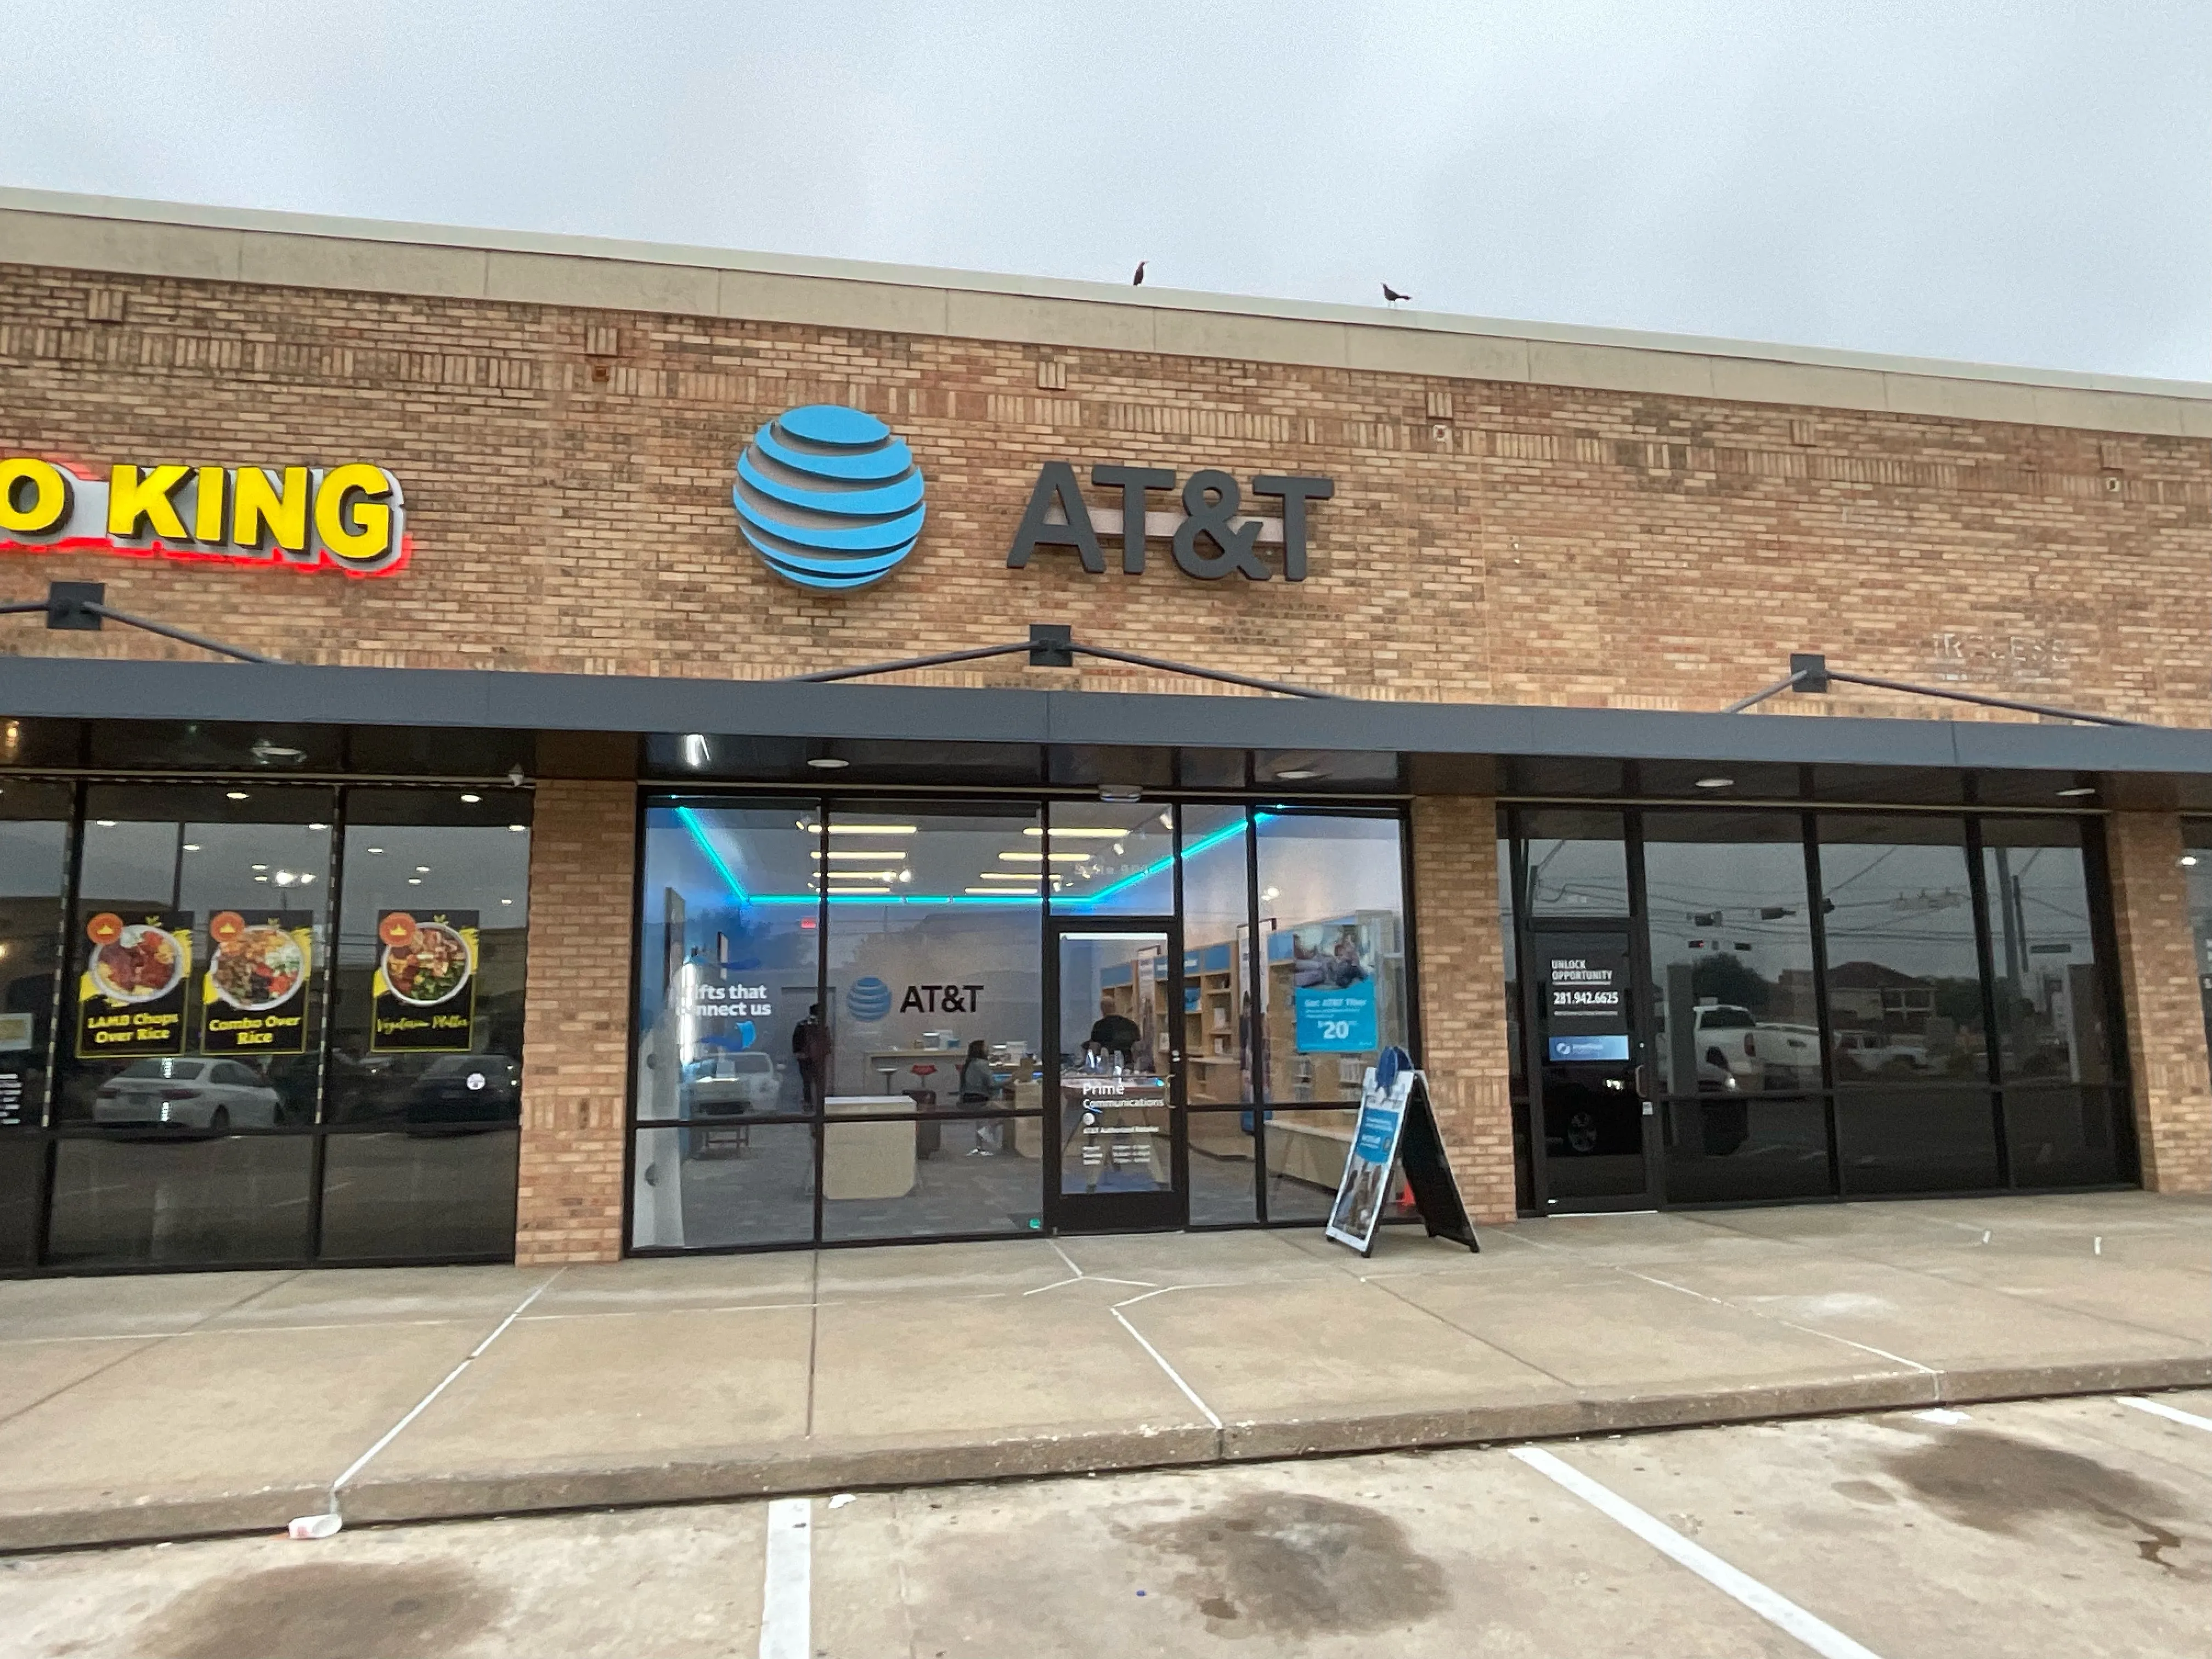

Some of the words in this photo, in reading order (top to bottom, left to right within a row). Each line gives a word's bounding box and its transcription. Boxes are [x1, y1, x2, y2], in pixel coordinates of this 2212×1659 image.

[108, 462, 393, 562] KING
[1006, 461, 1335, 582] AT&T
[1551, 959, 1585, 969] UNLOCK
[1551, 970, 1613, 980] OPPORTUNITY
[729, 983, 767, 1000] that
[900, 984, 984, 1013] AT&T
[751, 1004, 771, 1016] us
[1083, 1082, 1125, 1096] Prime
